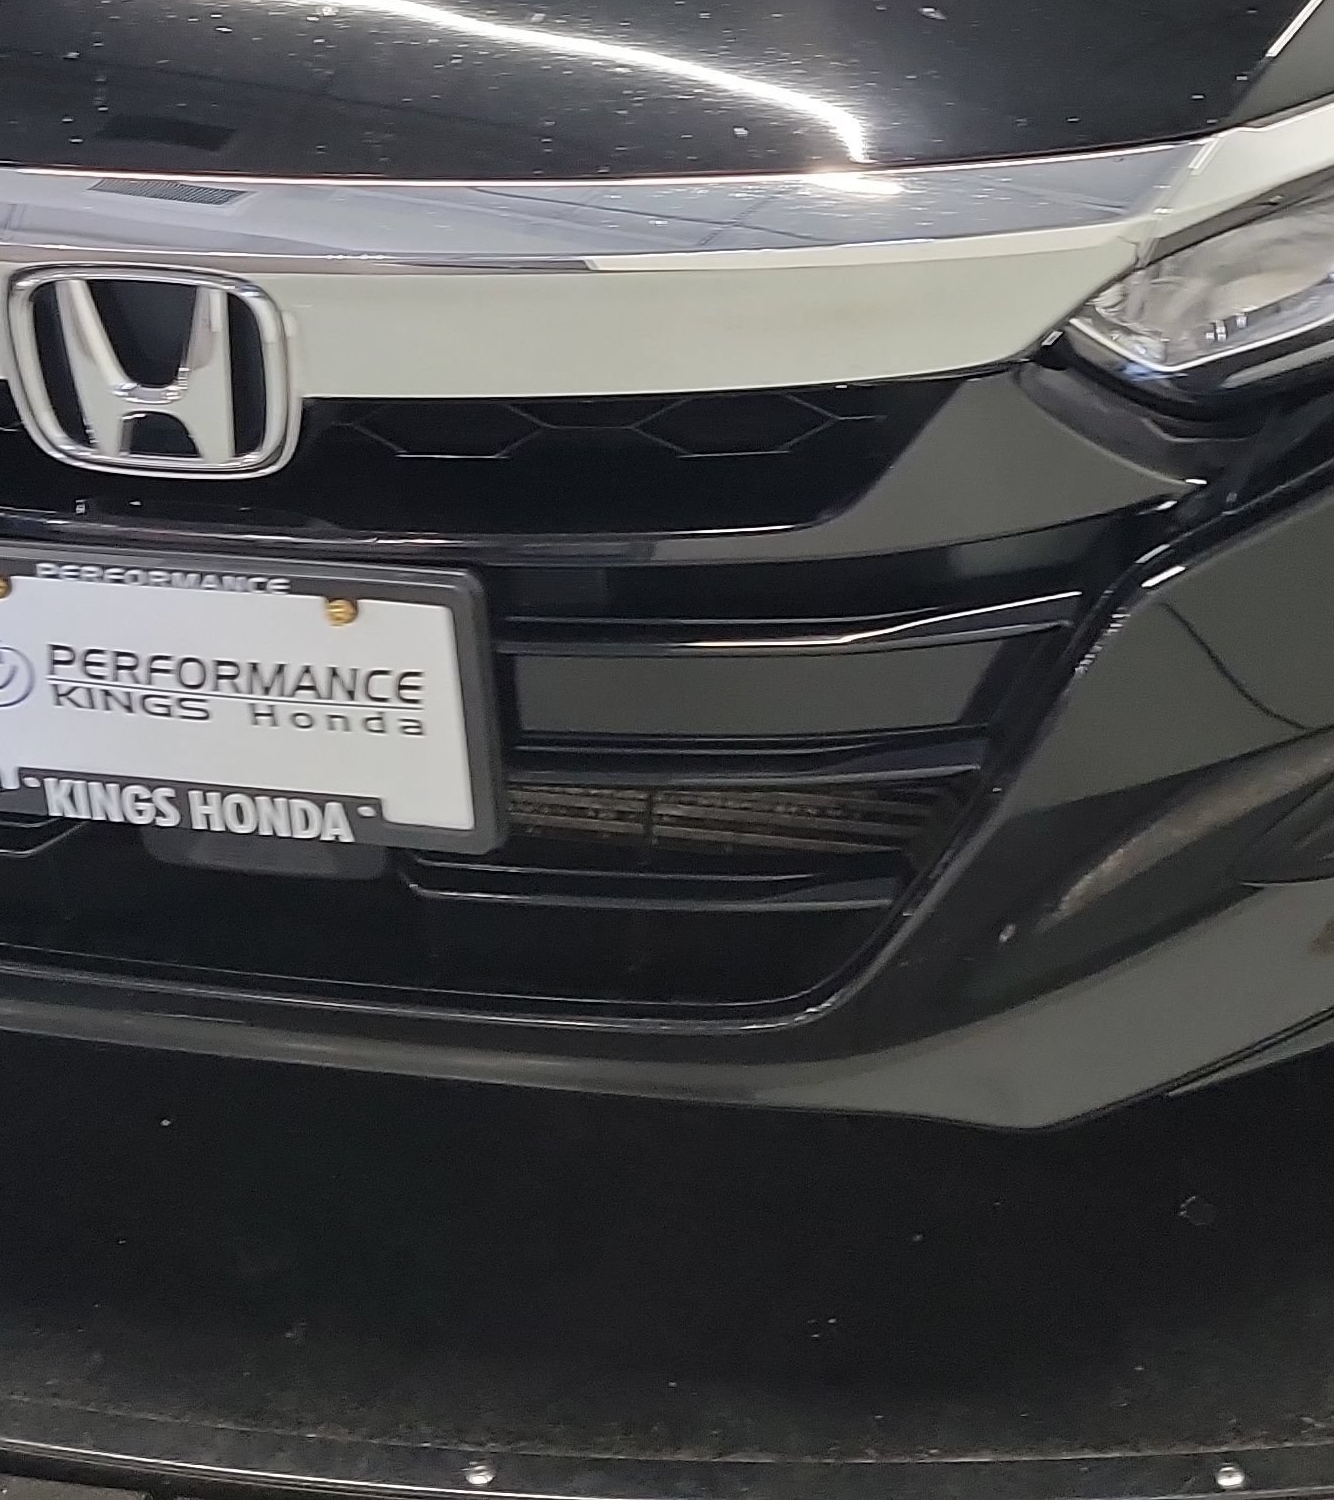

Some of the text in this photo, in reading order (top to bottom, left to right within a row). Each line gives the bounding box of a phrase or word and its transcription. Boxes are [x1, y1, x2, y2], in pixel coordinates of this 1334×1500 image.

[35, 563, 291, 594] PERFORMANCE
[46, 643, 424, 704] PERFORMANCE
[52, 684, 424, 736] KINGS Honda
[43, 777, 356, 843] KINGS HONDA
